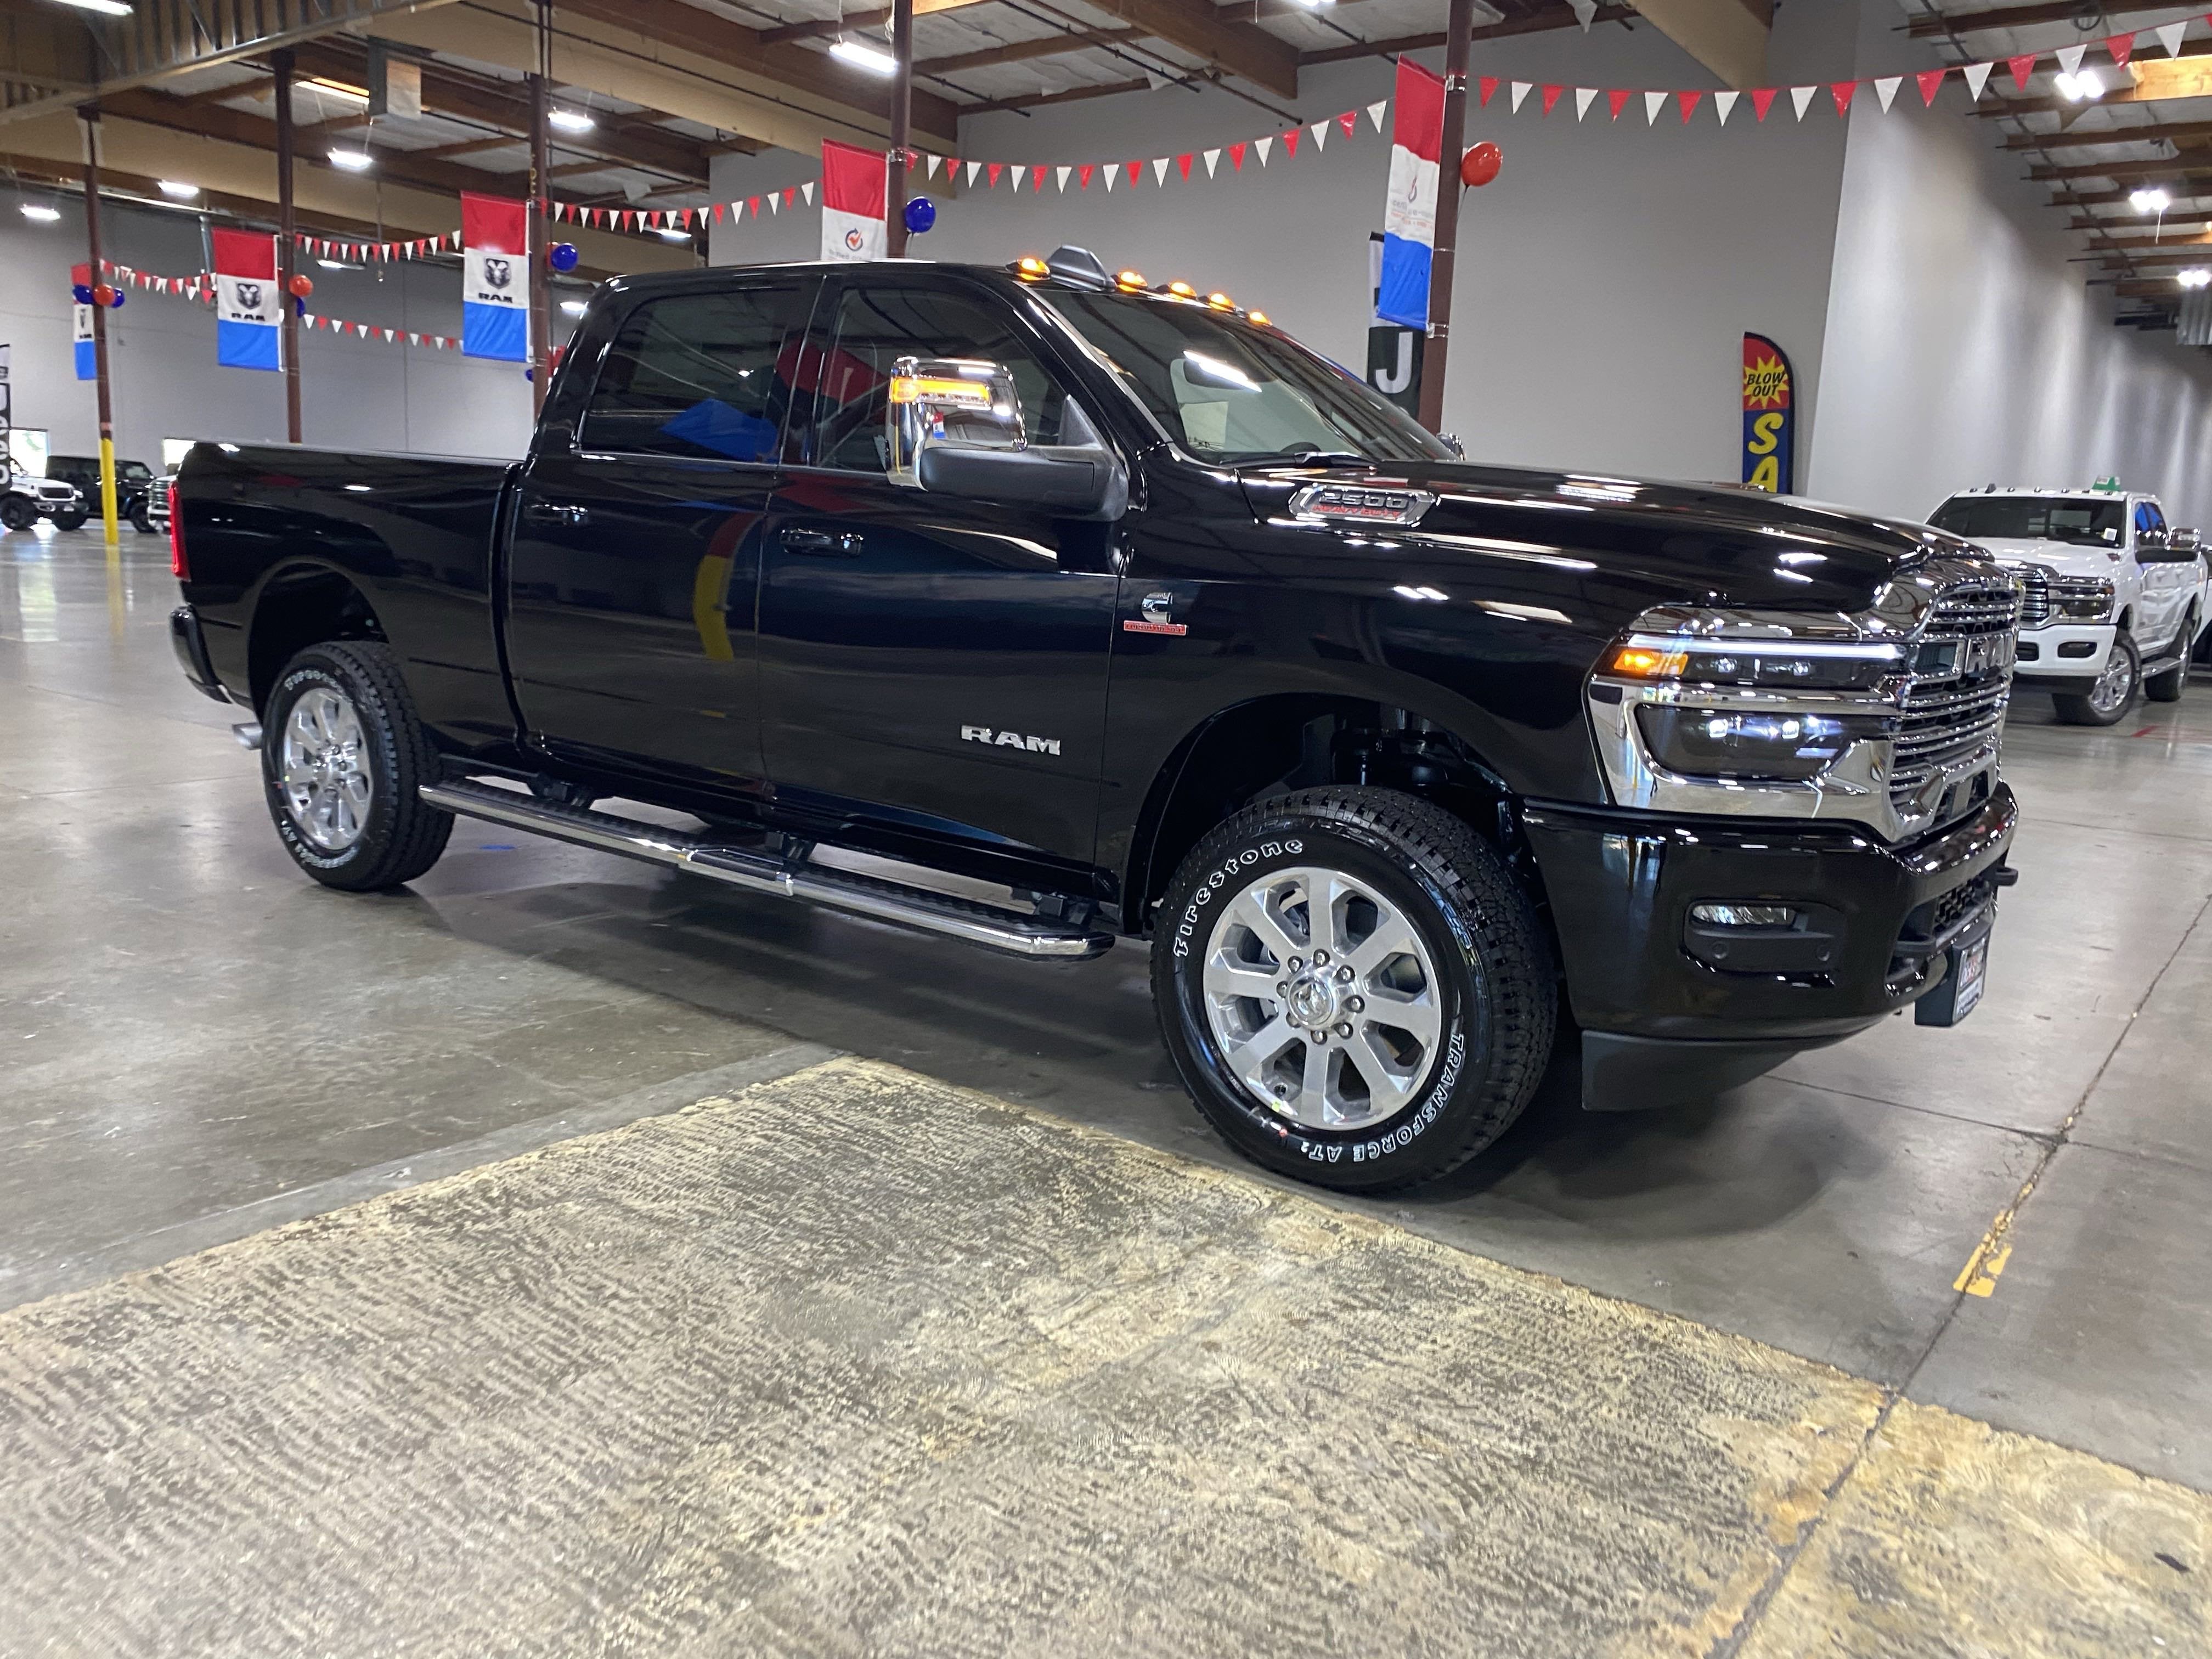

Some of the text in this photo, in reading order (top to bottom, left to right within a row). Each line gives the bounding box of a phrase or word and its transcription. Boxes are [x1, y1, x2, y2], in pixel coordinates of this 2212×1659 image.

[1747, 372, 1785, 385] BLOW
[1752, 385, 1779, 397] OUT
[1319, 492, 1408, 509] 2500
[961, 725, 1060, 756] RAM
[1173, 839, 1304, 957] Firestone
[1352, 1033, 1464, 1163] TRANSFORCE
